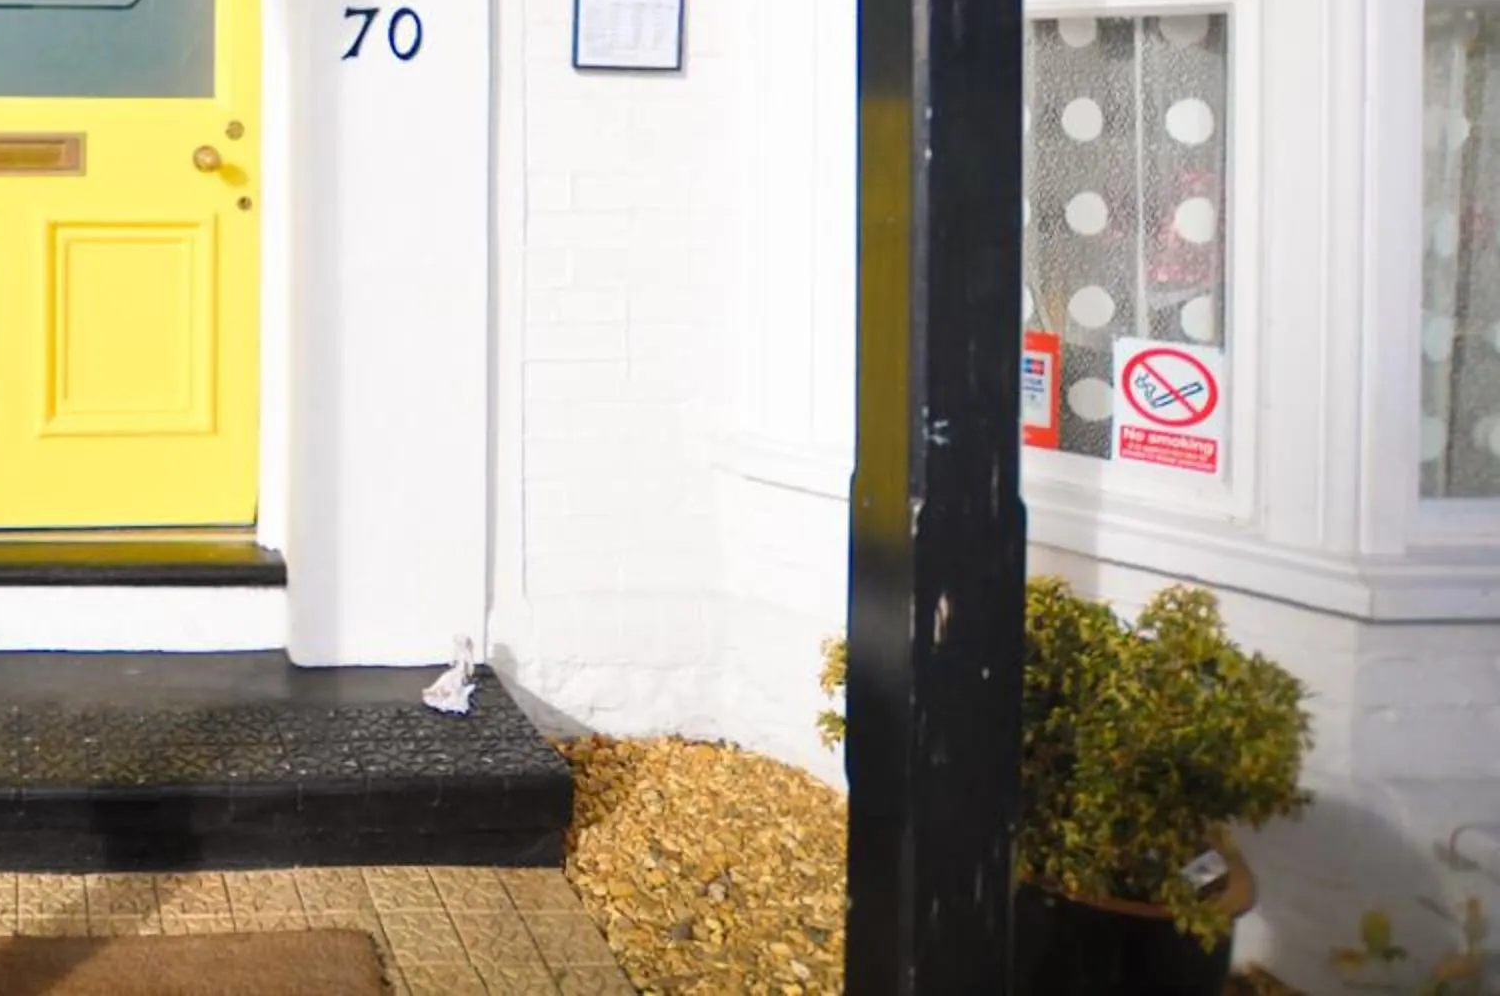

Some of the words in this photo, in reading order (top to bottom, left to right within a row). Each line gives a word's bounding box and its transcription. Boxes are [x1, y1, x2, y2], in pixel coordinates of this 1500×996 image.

[342, 6, 422, 61] 70
[1123, 427, 1145, 443] No
[1147, 434, 1214, 456] smoking
